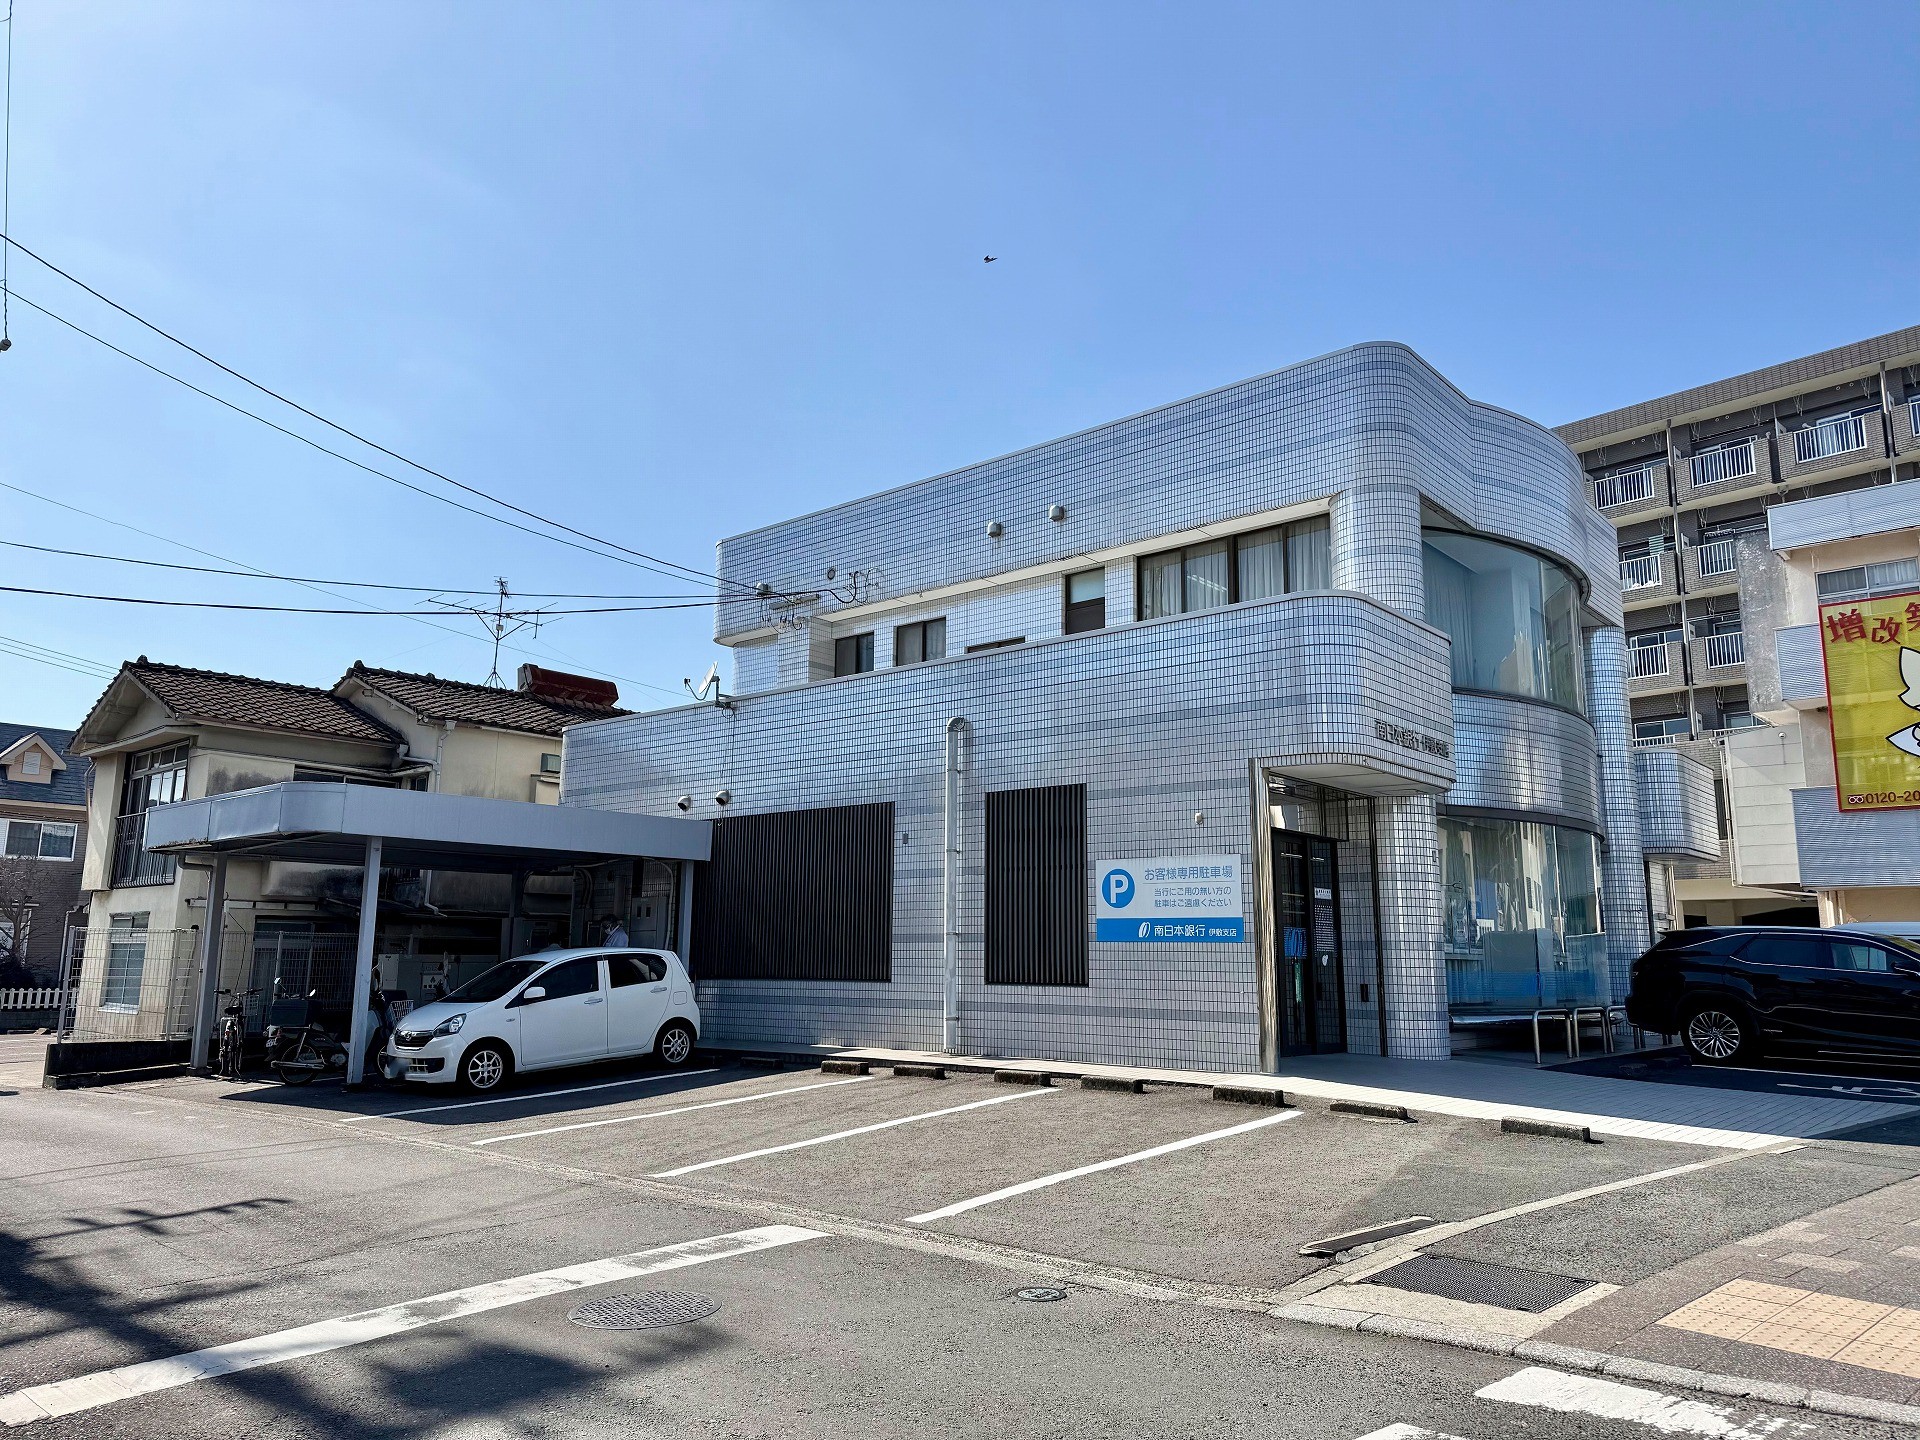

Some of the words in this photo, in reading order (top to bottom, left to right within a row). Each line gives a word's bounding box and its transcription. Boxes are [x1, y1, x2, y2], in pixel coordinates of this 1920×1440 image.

[1144, 866, 1233, 880] お客様専用駐車場
[1110, 875, 1128, 903] P
[1154, 887, 1231, 897] 当行にご用の無い方の
[1154, 898, 1232, 907] 駐車はご遠慮ください
[1154, 925, 1205, 937] 南日本銀行
[1209, 929, 1237, 937] 伊敷支店
